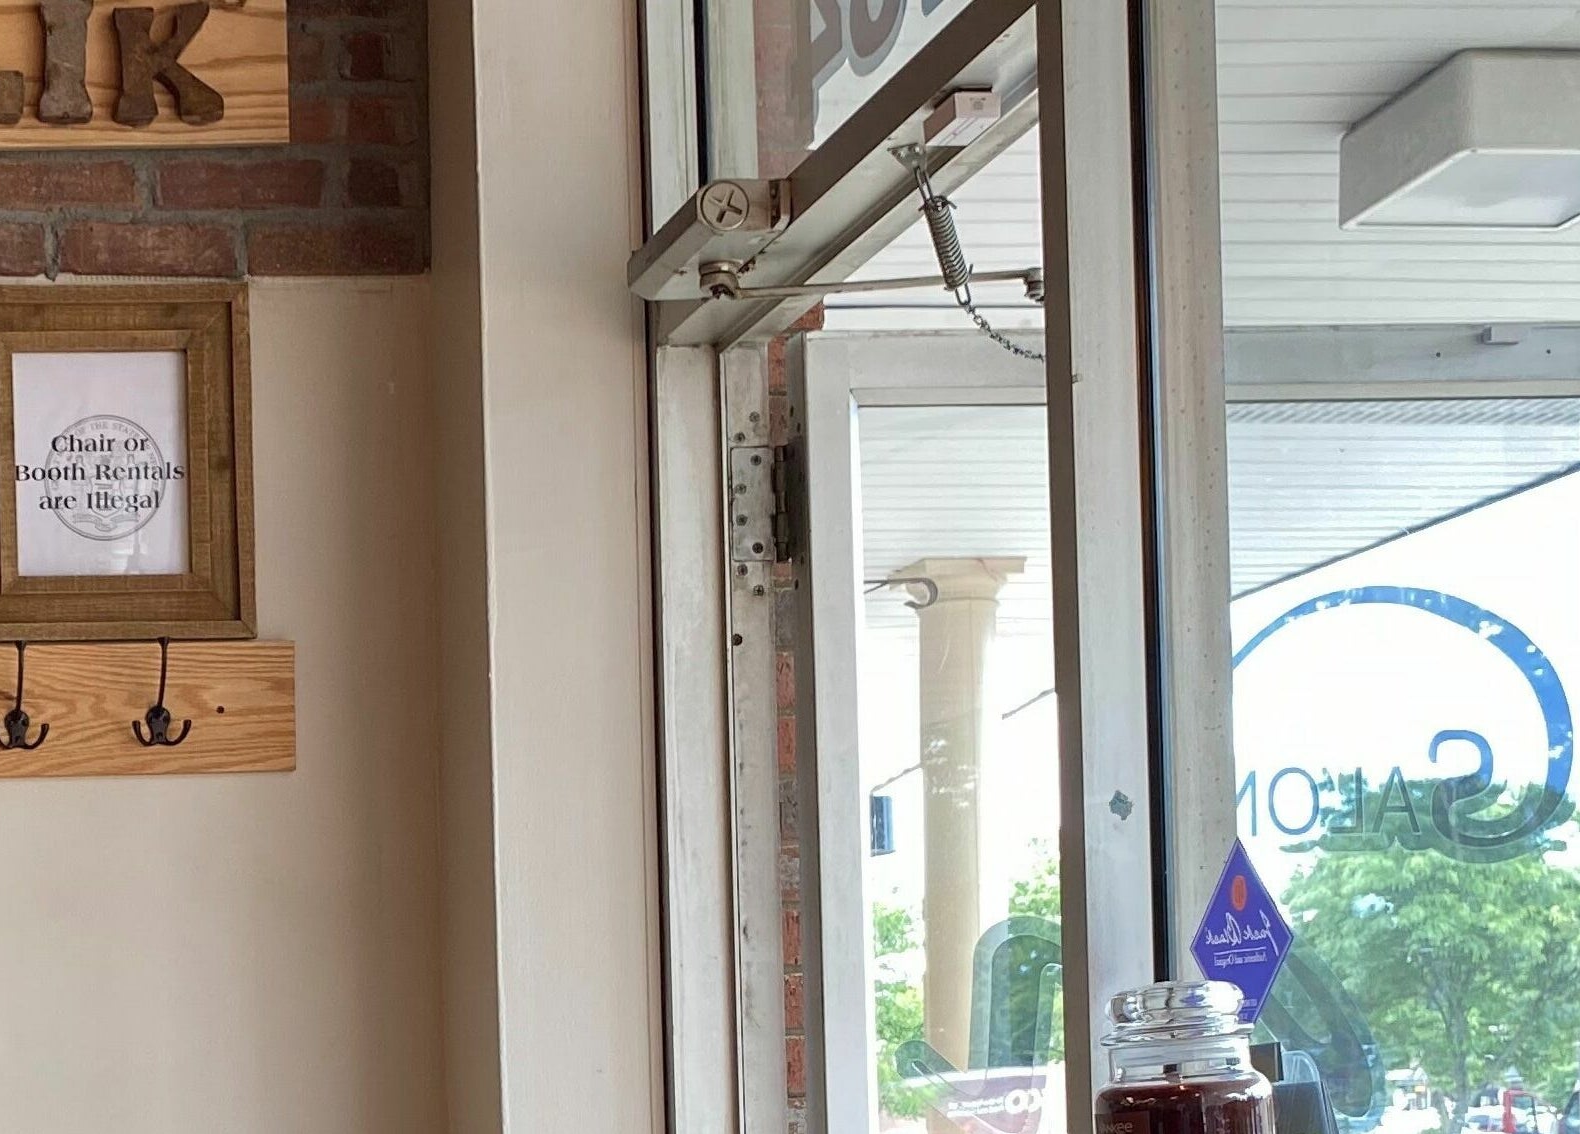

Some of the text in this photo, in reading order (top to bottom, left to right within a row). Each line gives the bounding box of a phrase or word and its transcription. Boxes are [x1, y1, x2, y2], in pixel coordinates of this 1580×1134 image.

[51, 433, 149, 453] Chair or
[15, 462, 86, 482] Booth
[95, 461, 185, 481] Rentals
[38, 490, 161, 513] are Illegal
